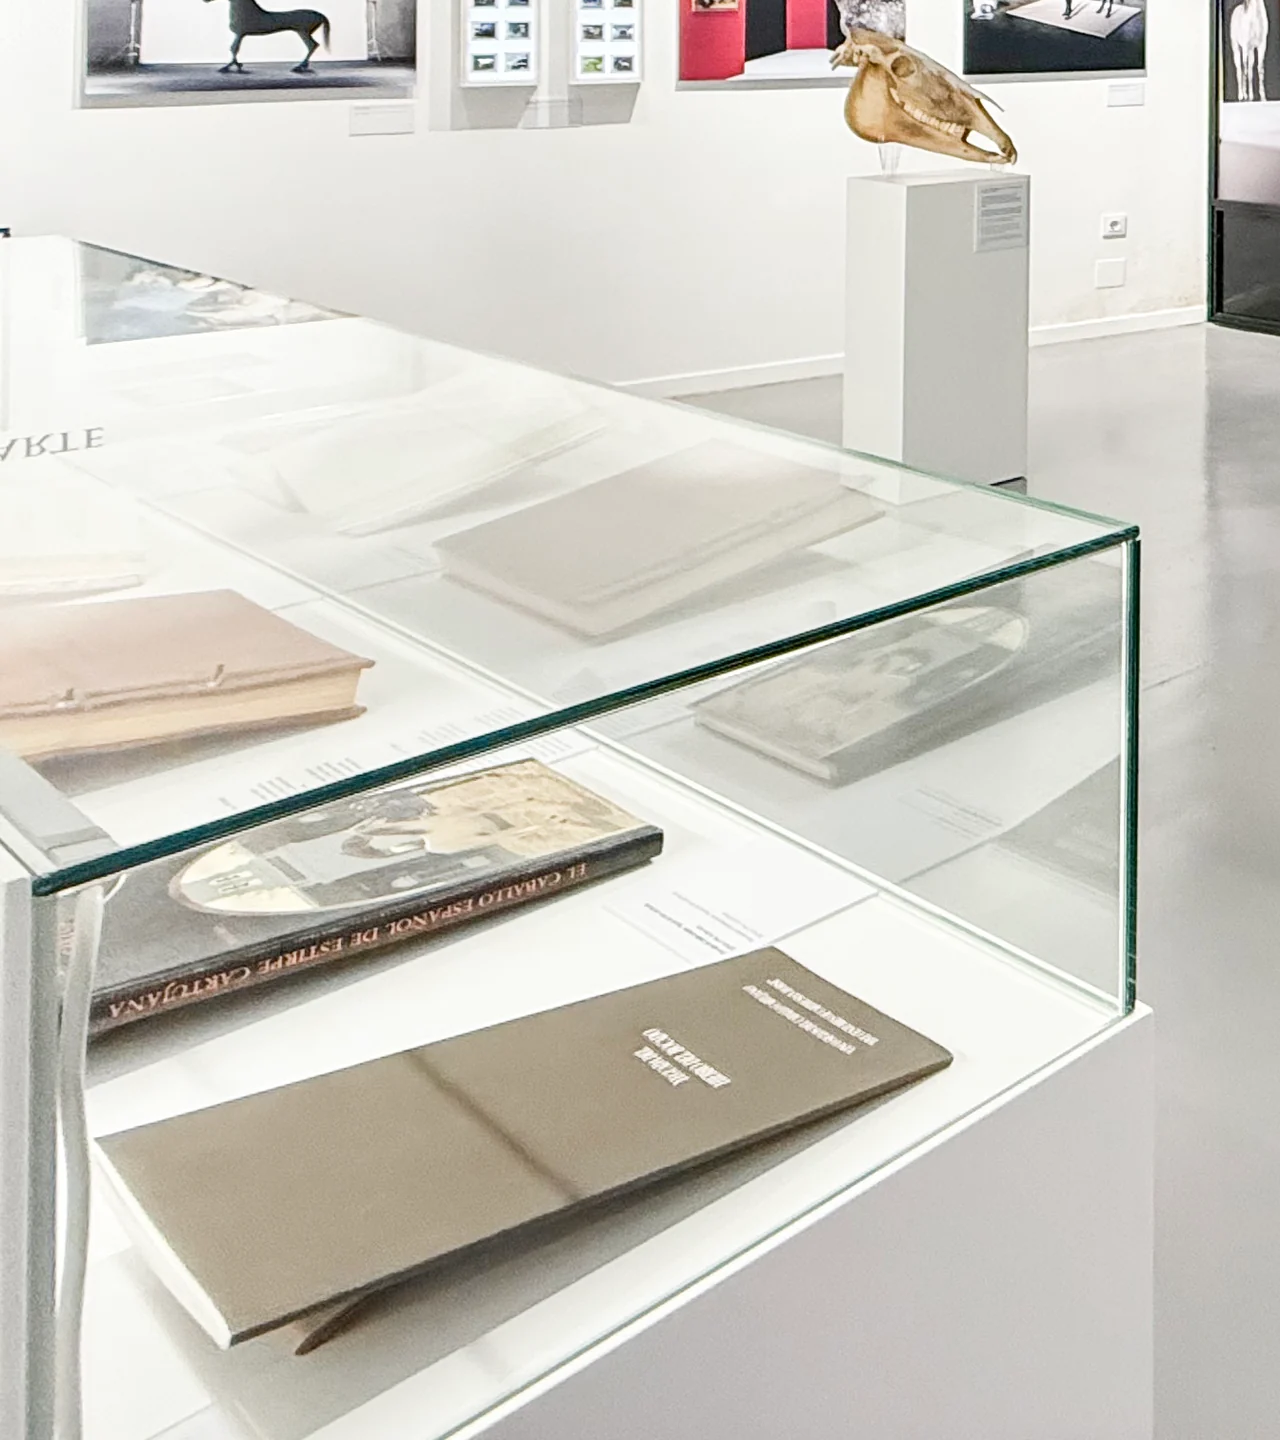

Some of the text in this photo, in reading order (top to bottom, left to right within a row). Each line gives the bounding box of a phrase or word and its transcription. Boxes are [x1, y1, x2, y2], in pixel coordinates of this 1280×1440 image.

[568, 863, 588, 879] EL
[479, 872, 561, 907] CABALLO
[349, 927, 378, 946] DE
[257, 937, 344, 975] ESTIRPE
[108, 966, 251, 1018] CARTUJANA
